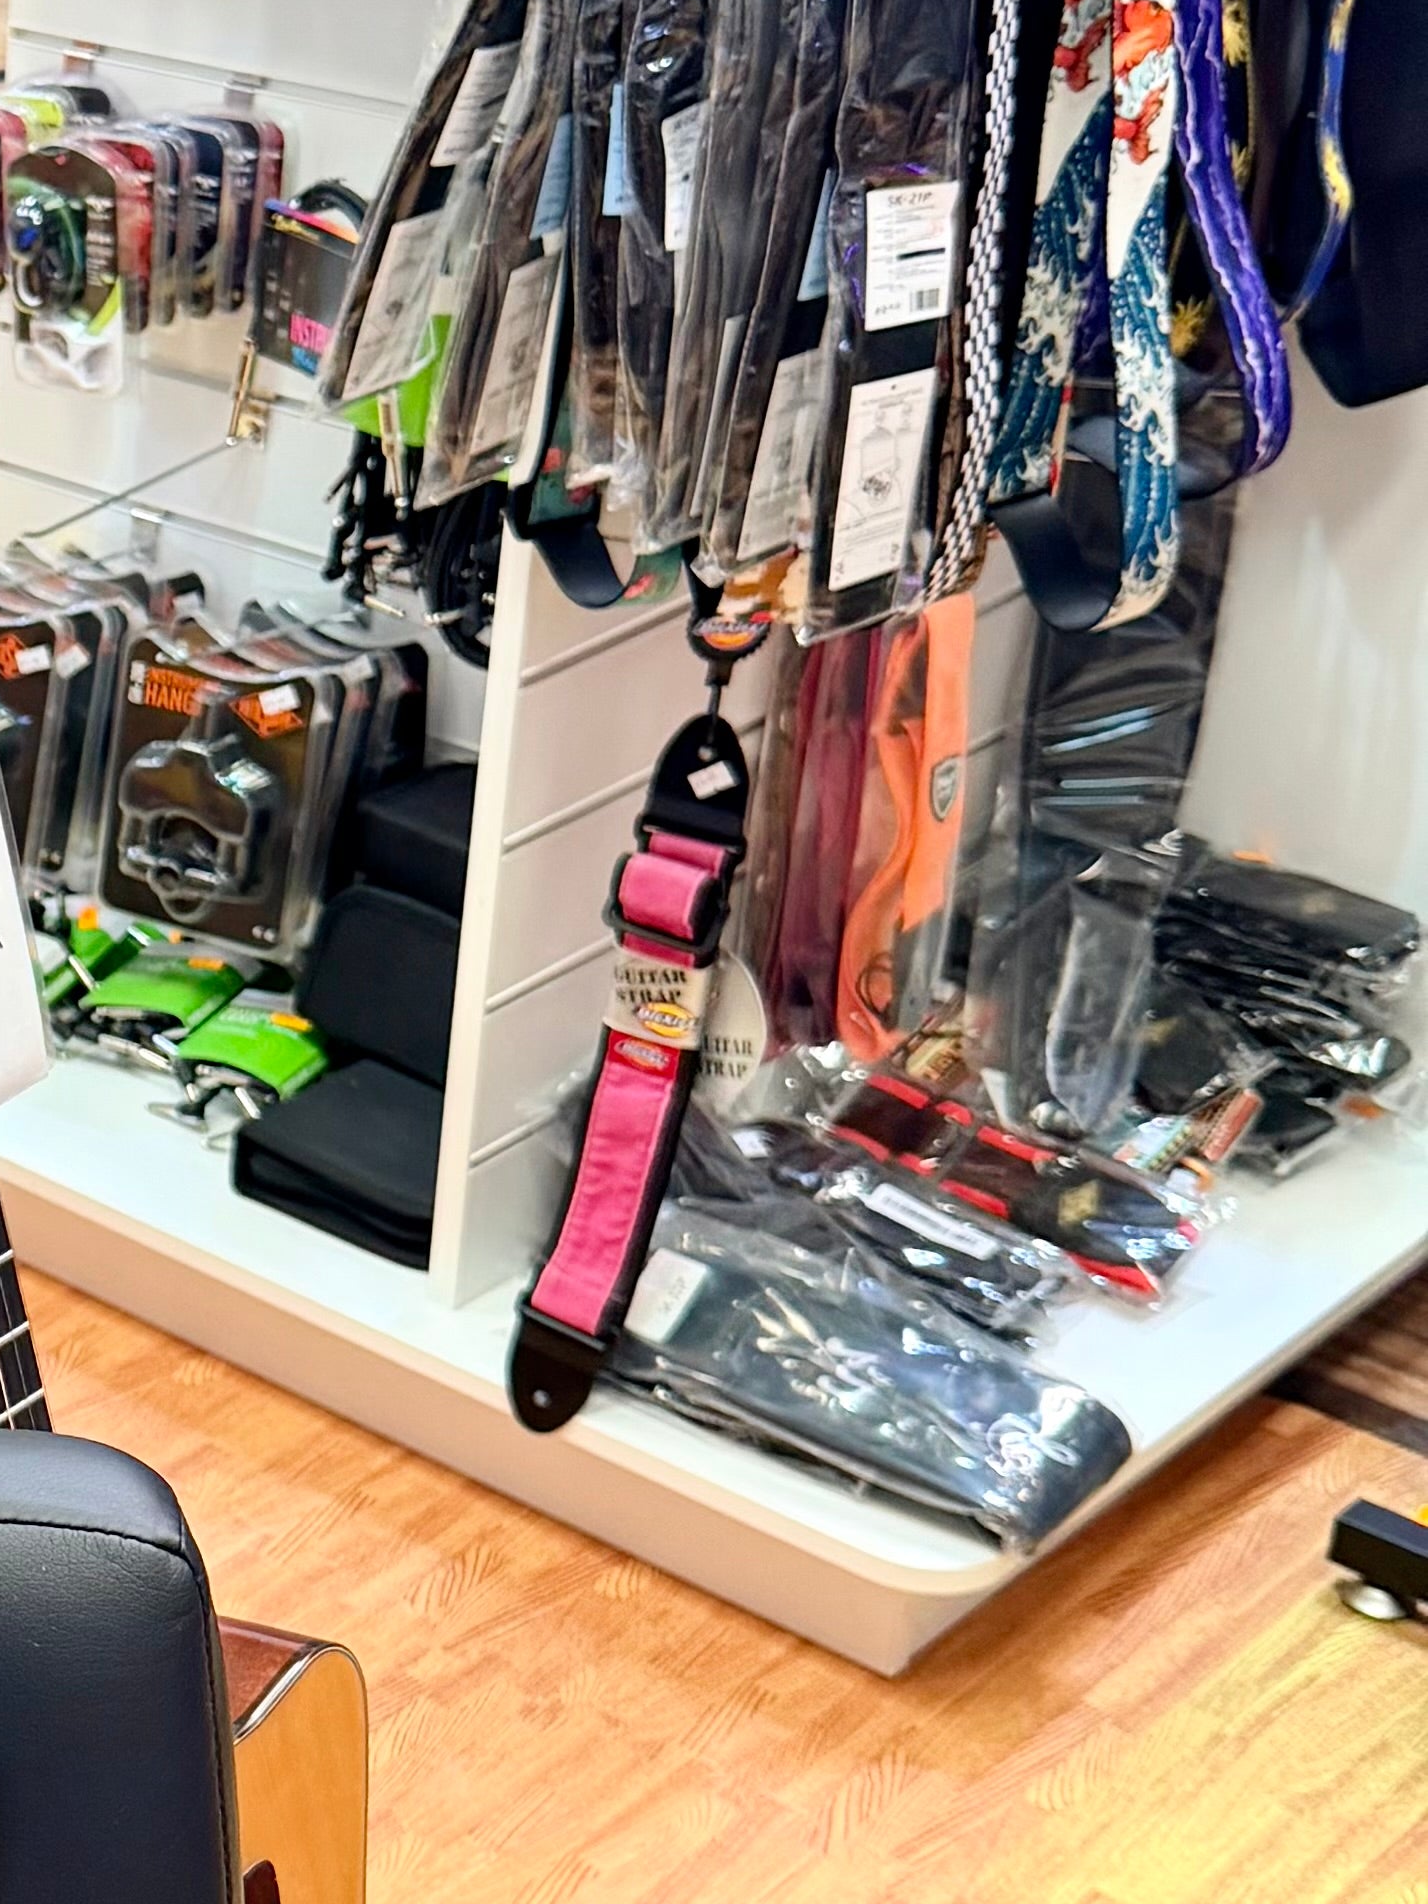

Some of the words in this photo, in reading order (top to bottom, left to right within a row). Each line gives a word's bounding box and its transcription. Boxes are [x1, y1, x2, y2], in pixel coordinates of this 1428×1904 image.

[614, 968, 687, 984] GUITAR
[615, 988, 682, 1004] STRAP
[704, 1034, 752, 1054] UITAR
[700, 1059, 748, 1078] TRAP
